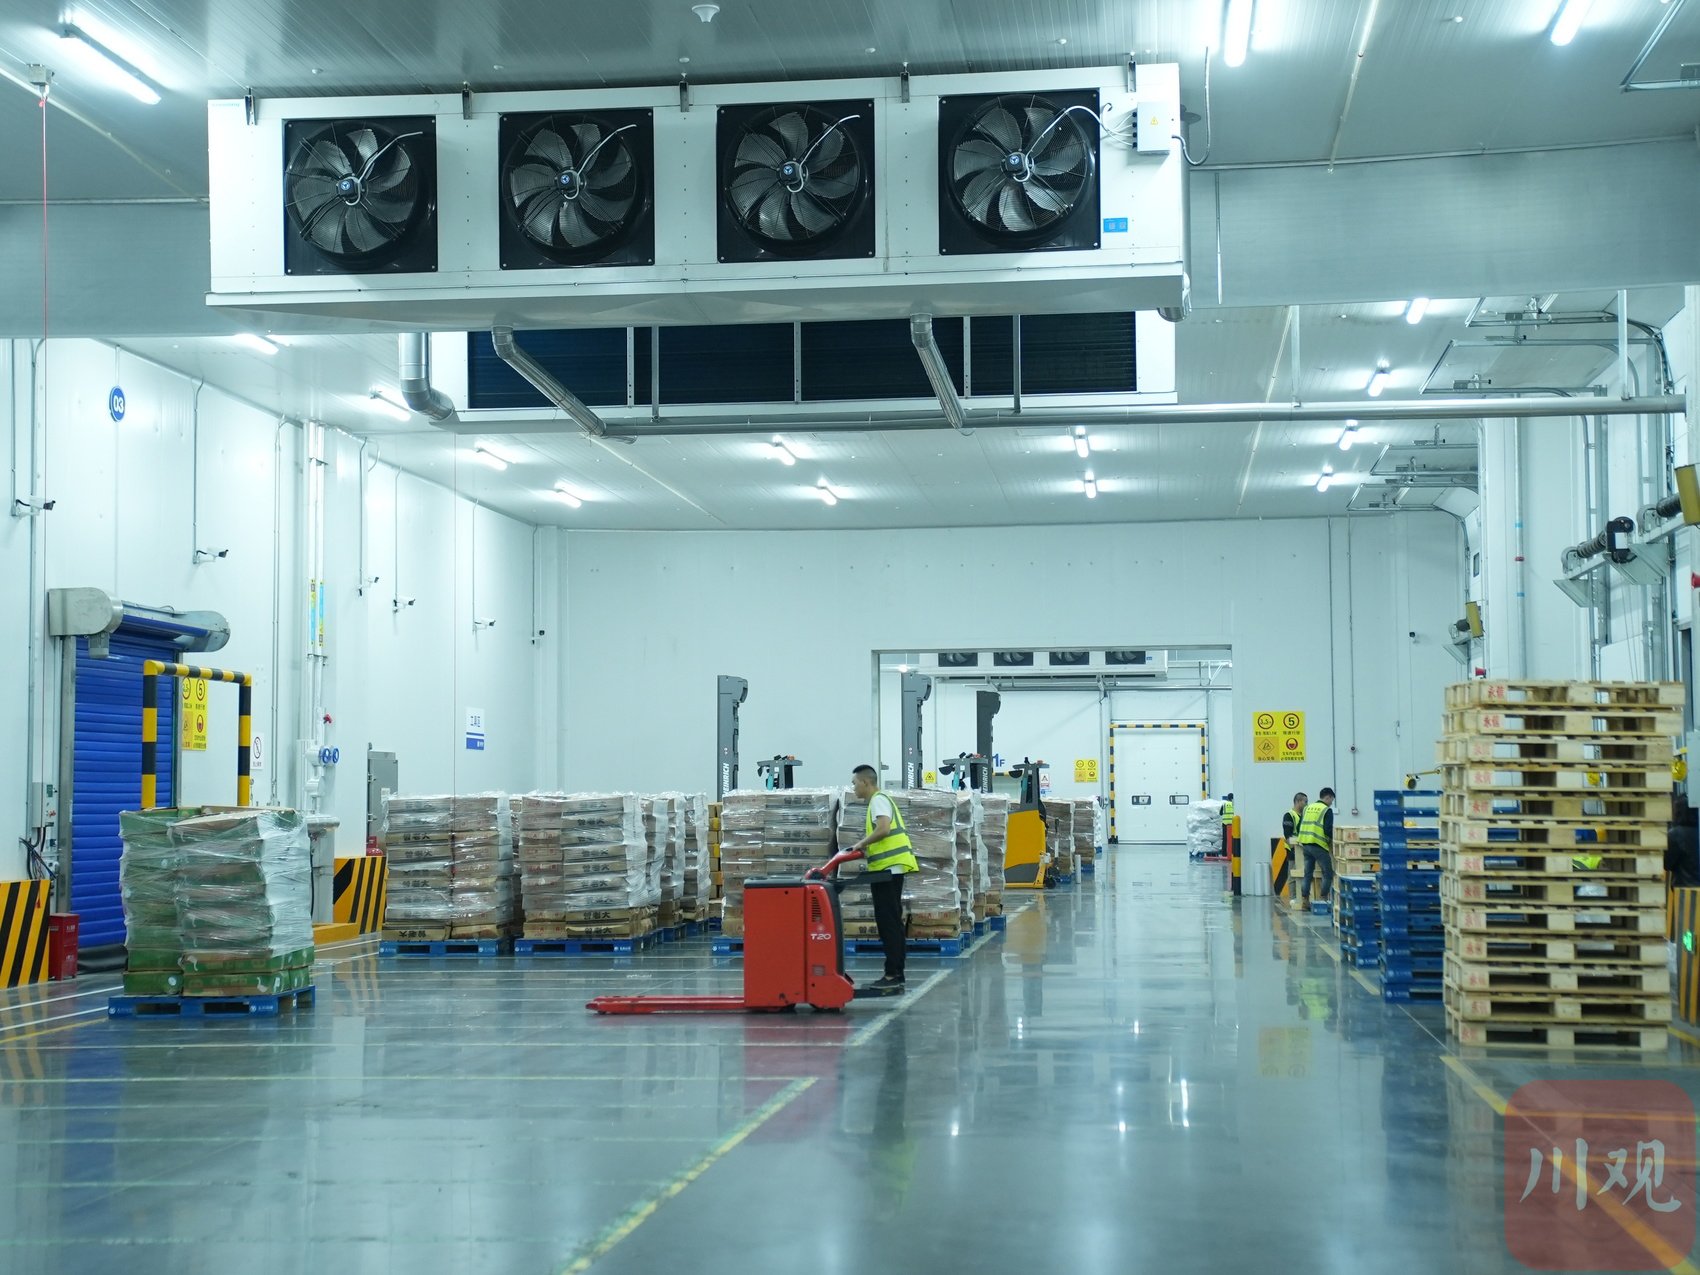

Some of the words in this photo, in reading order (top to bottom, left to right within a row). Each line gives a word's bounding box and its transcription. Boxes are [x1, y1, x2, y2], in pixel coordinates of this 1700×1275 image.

[113, 394, 124, 414] 03
[198, 682, 203, 696] 5
[1288, 716, 1295, 726] 5
[583, 911, 611, 920] 曾老大
[810, 933, 832, 941] T20
